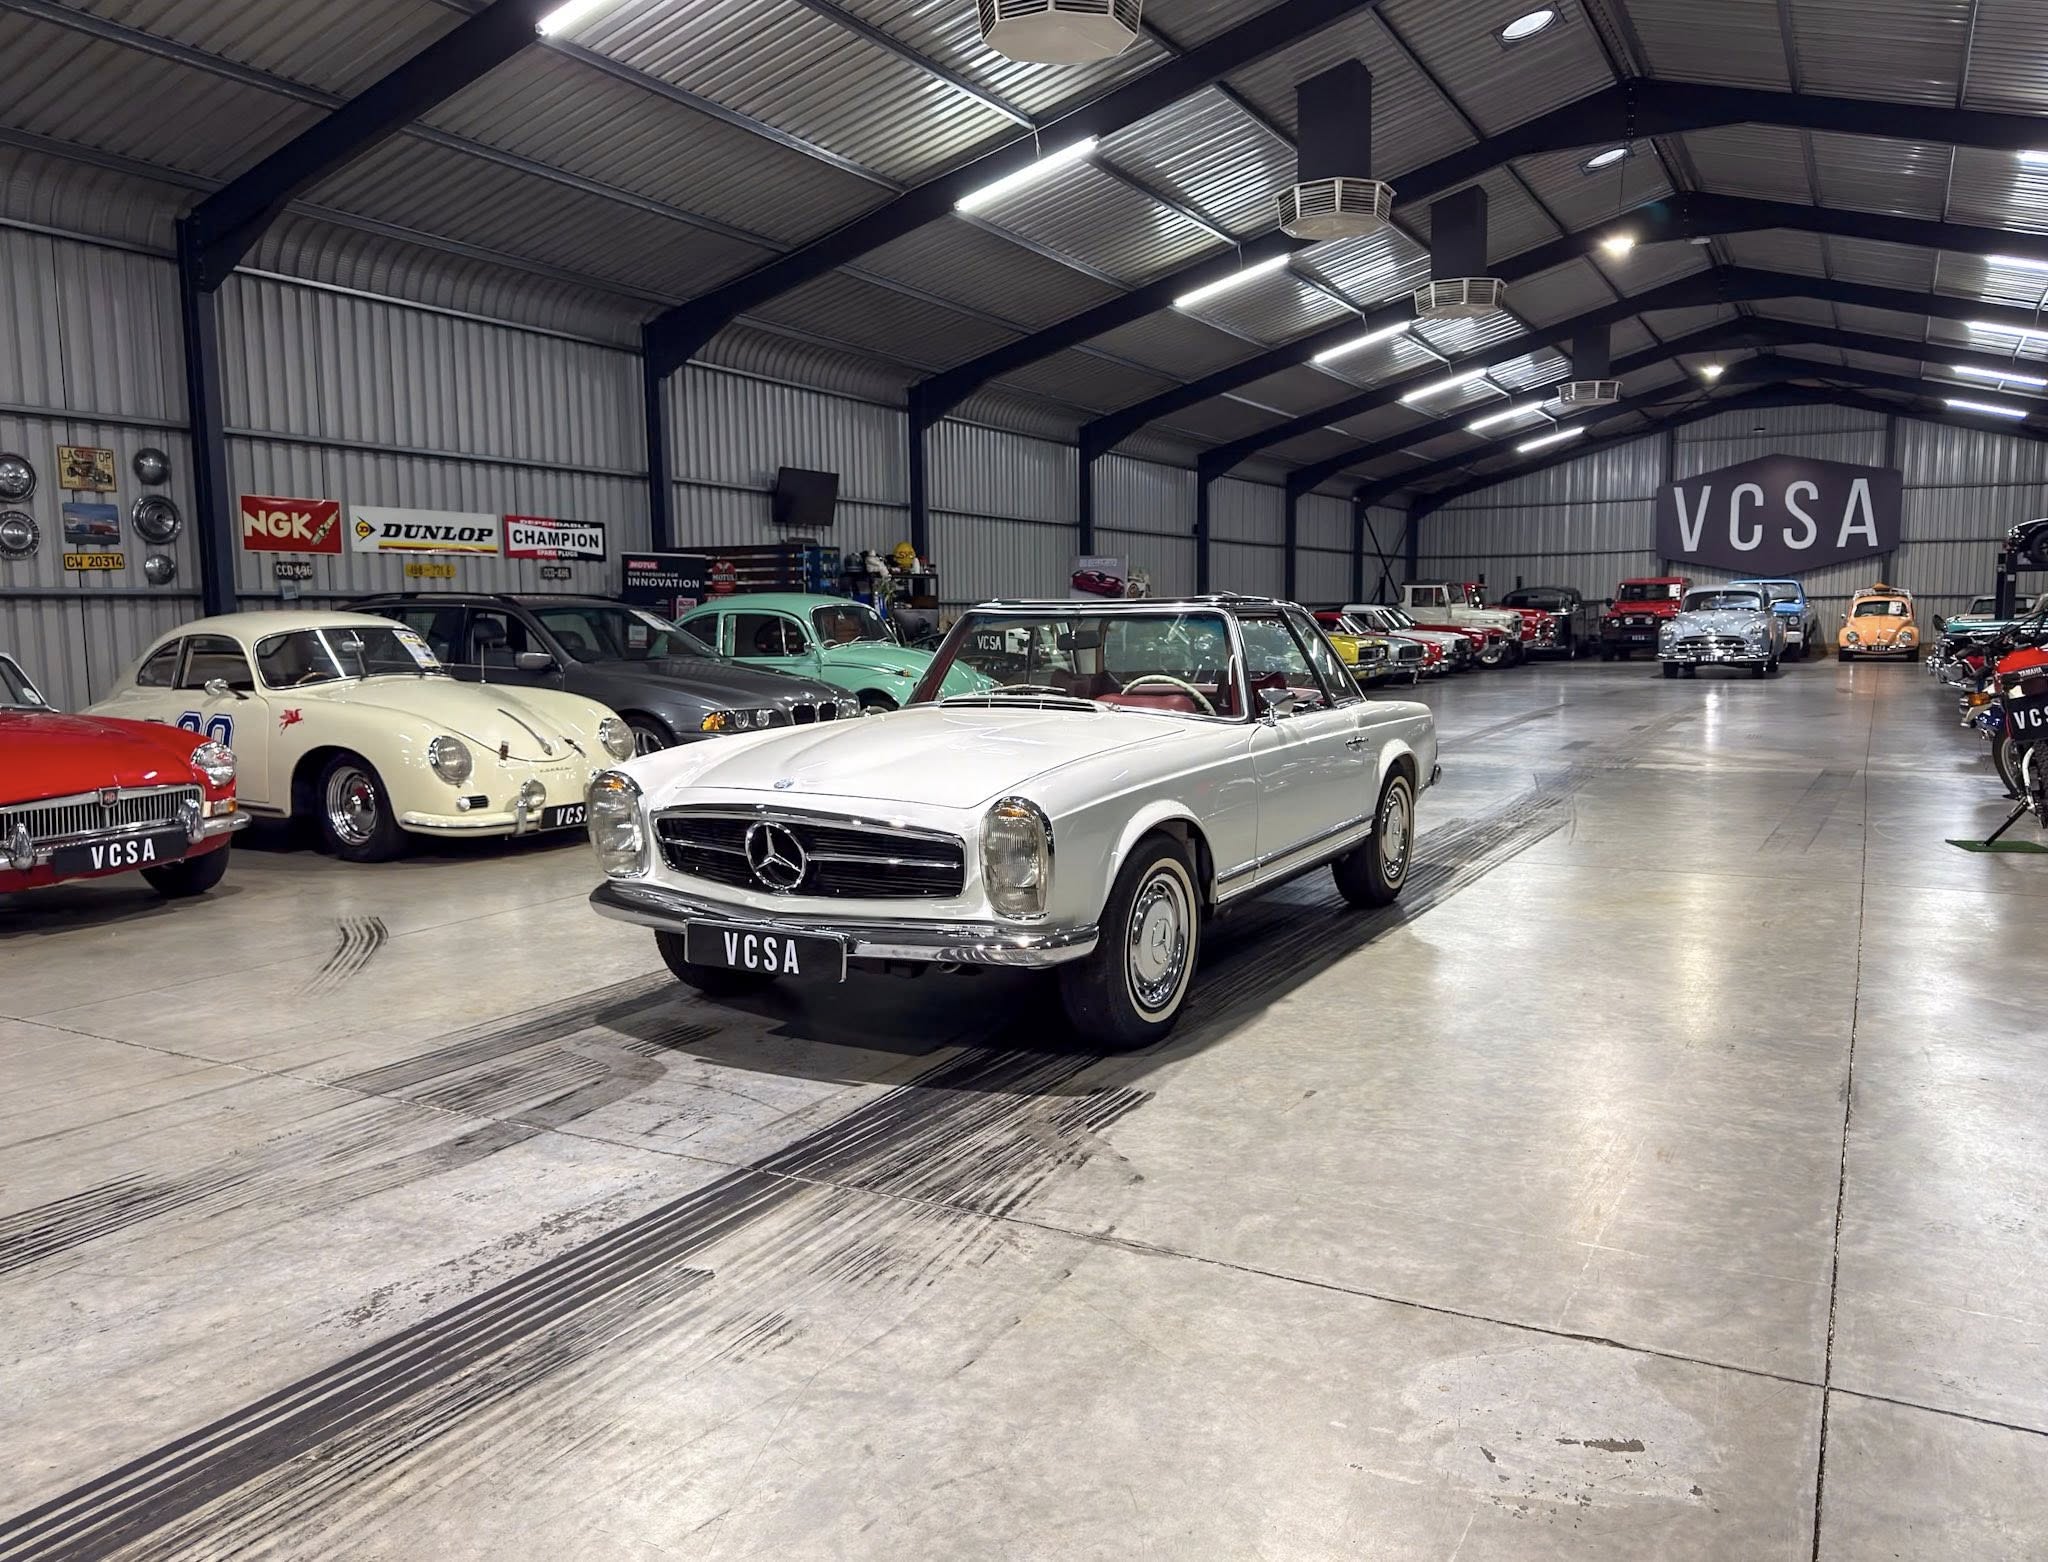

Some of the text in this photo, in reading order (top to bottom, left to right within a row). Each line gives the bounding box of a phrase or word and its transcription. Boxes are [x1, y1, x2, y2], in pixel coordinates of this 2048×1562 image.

[1673, 478, 1879, 552] VCSA
[242, 509, 313, 540] NGK
[520, 519, 591, 529] DEPENDABLE
[380, 523, 494, 542] DUNLOP
[512, 529, 600, 548] CHAMPION
[536, 549, 579, 558] SPARK PLUGS
[66, 556, 122, 568] CW 20314
[628, 561, 658, 570] MOTUL
[627, 577, 700, 589] INNOVATION
[977, 635, 1002, 651] VCSA
[2018, 666, 2043, 678] YAMAHA
[91, 838, 156, 870] VCSA
[724, 931, 799, 974] VCSA
